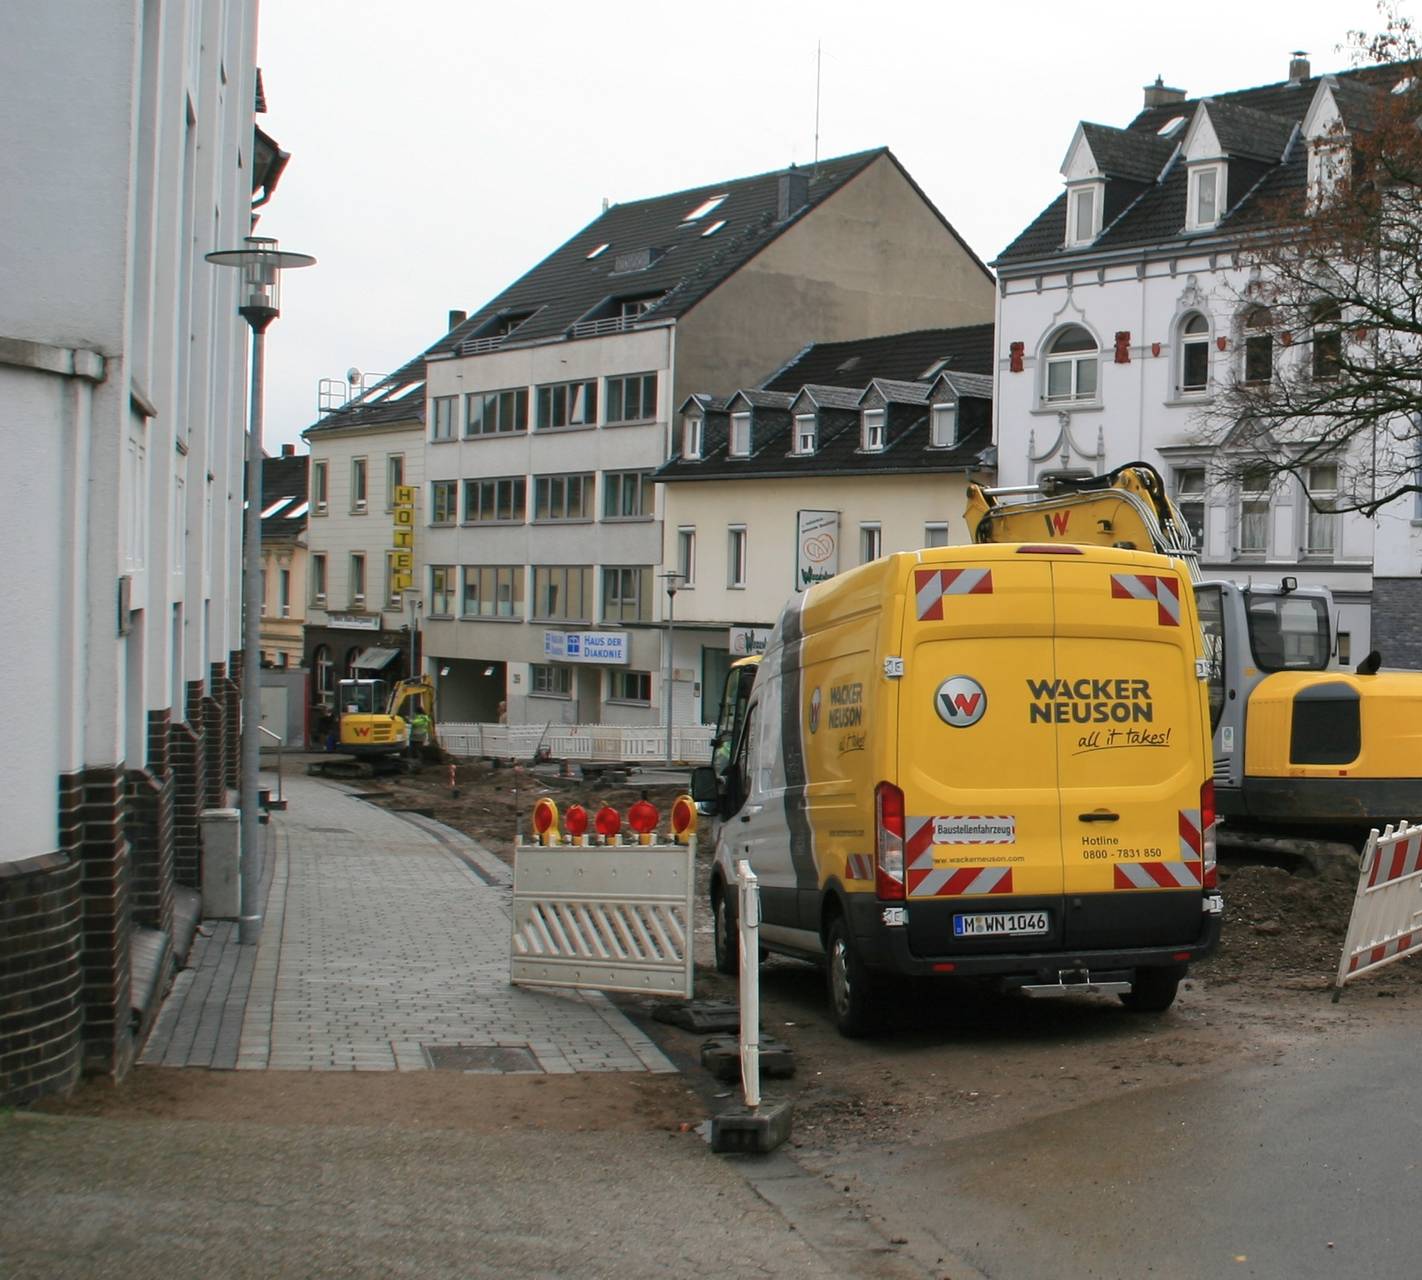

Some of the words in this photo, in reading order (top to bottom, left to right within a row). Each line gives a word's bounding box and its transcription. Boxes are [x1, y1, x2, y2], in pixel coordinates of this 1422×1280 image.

[396, 488, 412, 590] HOTEL
[584, 634, 605, 647] HAUS
[607, 637, 623, 647] DER
[584, 647, 622, 659] DIAKONIE
[1026, 678, 1153, 700] WACKER
[828, 705, 863, 729] NEUSON
[1030, 701, 1153, 724] NEUSON
[1078, 731, 1100, 747] all
[1107, 728, 1123, 745] it
[1126, 727, 1172, 745] takes!
[937, 824, 1011, 837] Baustellenfahrzeug
[1081, 836, 1119, 846] Hotline
[1083, 849, 1108, 859] 0800
[1117, 848, 1141, 858] 7831
[1144, 847, 1162, 858] 850
[964, 917, 975, 933] M
[984, 916, 1005, 932] WN
[1007, 914, 1046, 931] 1046
